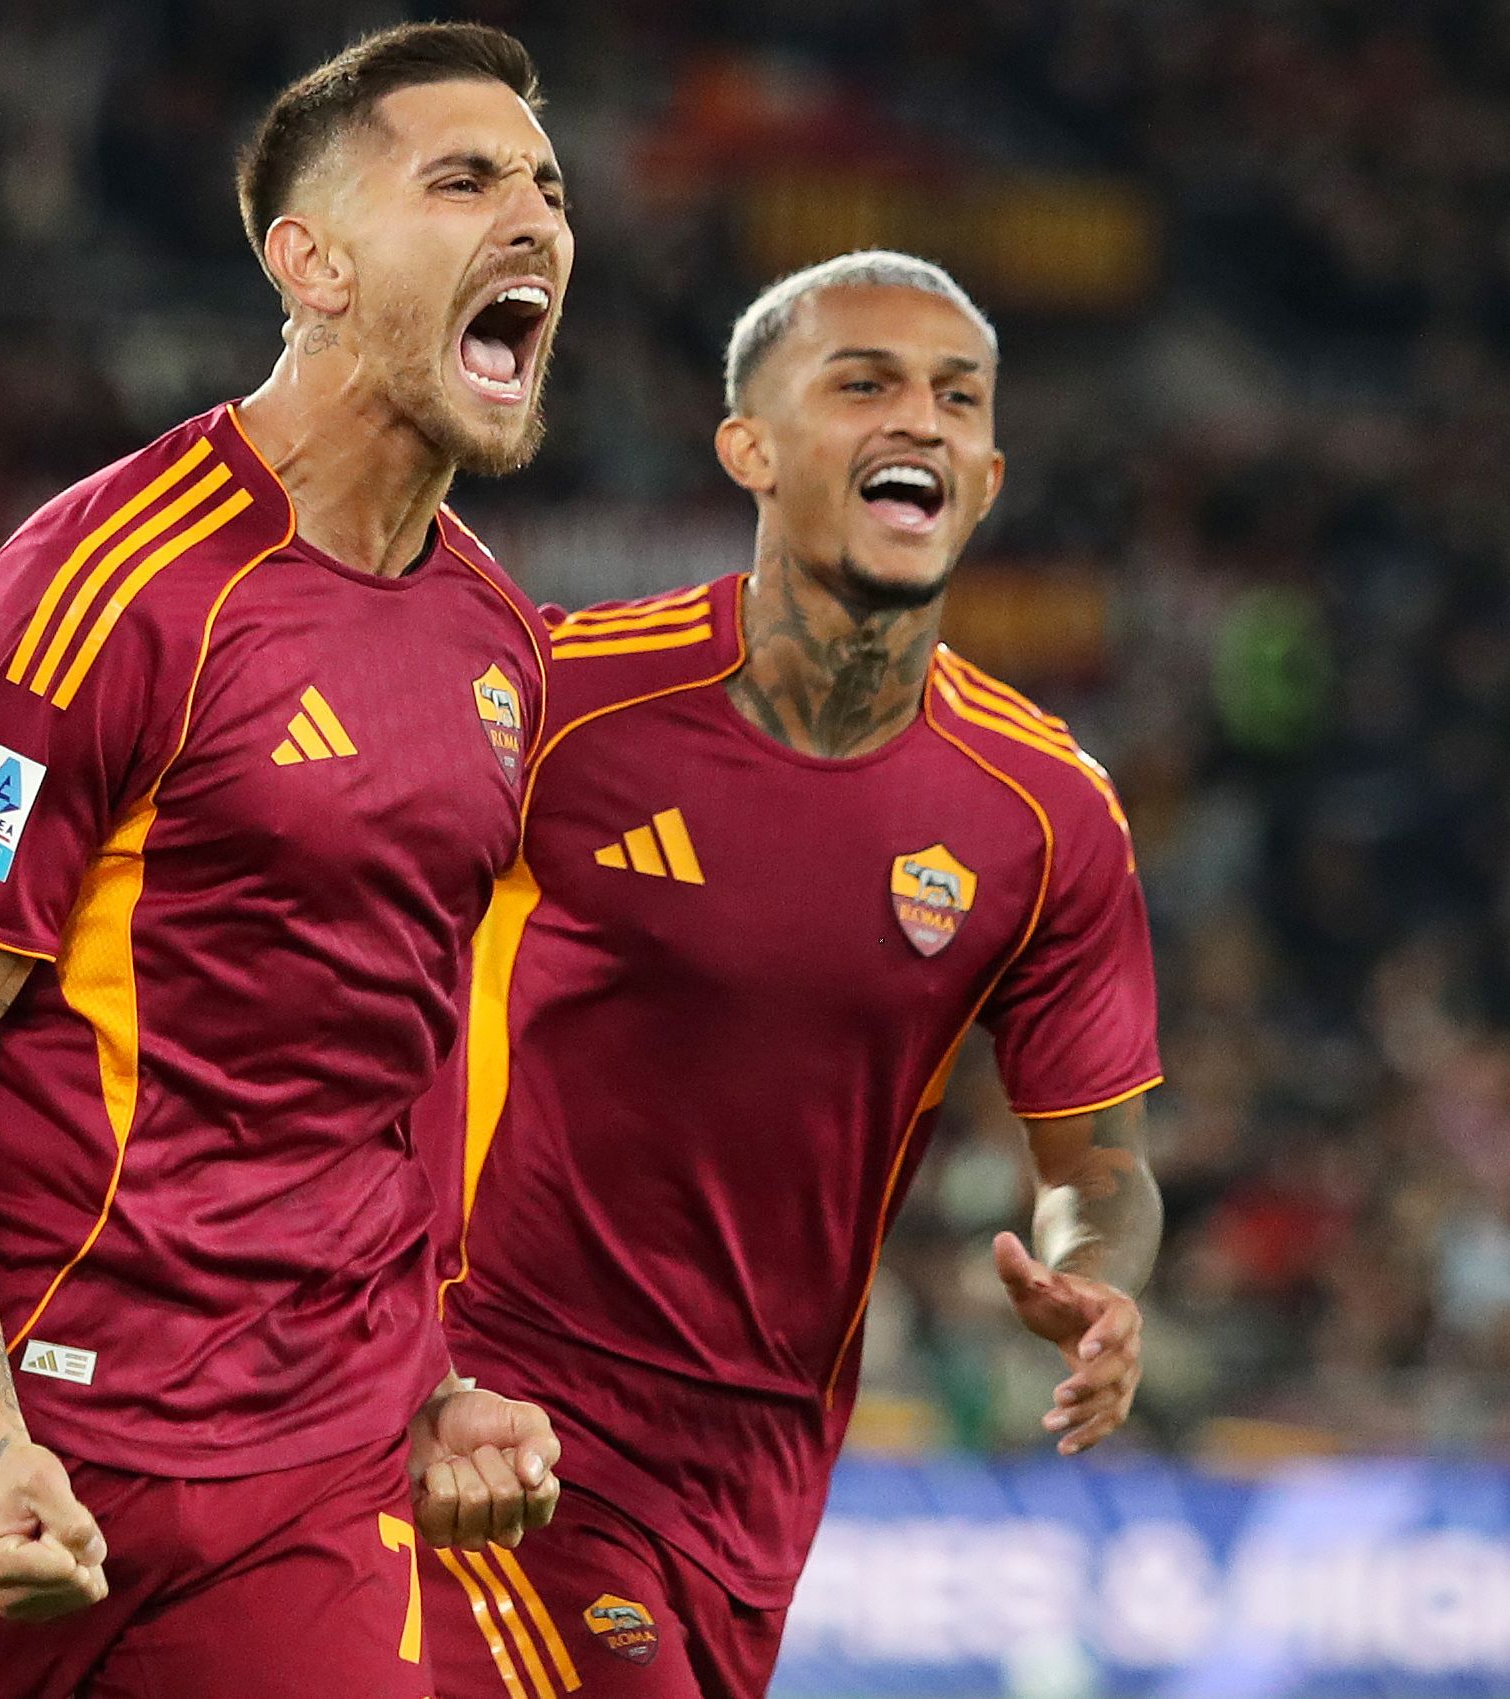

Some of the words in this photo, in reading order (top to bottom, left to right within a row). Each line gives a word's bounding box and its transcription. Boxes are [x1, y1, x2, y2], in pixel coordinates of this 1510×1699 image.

[6, 824, 14, 837] A
[899, 902, 956, 933] ROMA
[378, 1511, 422, 1664] 7
[607, 1630, 657, 1649] ROMA
